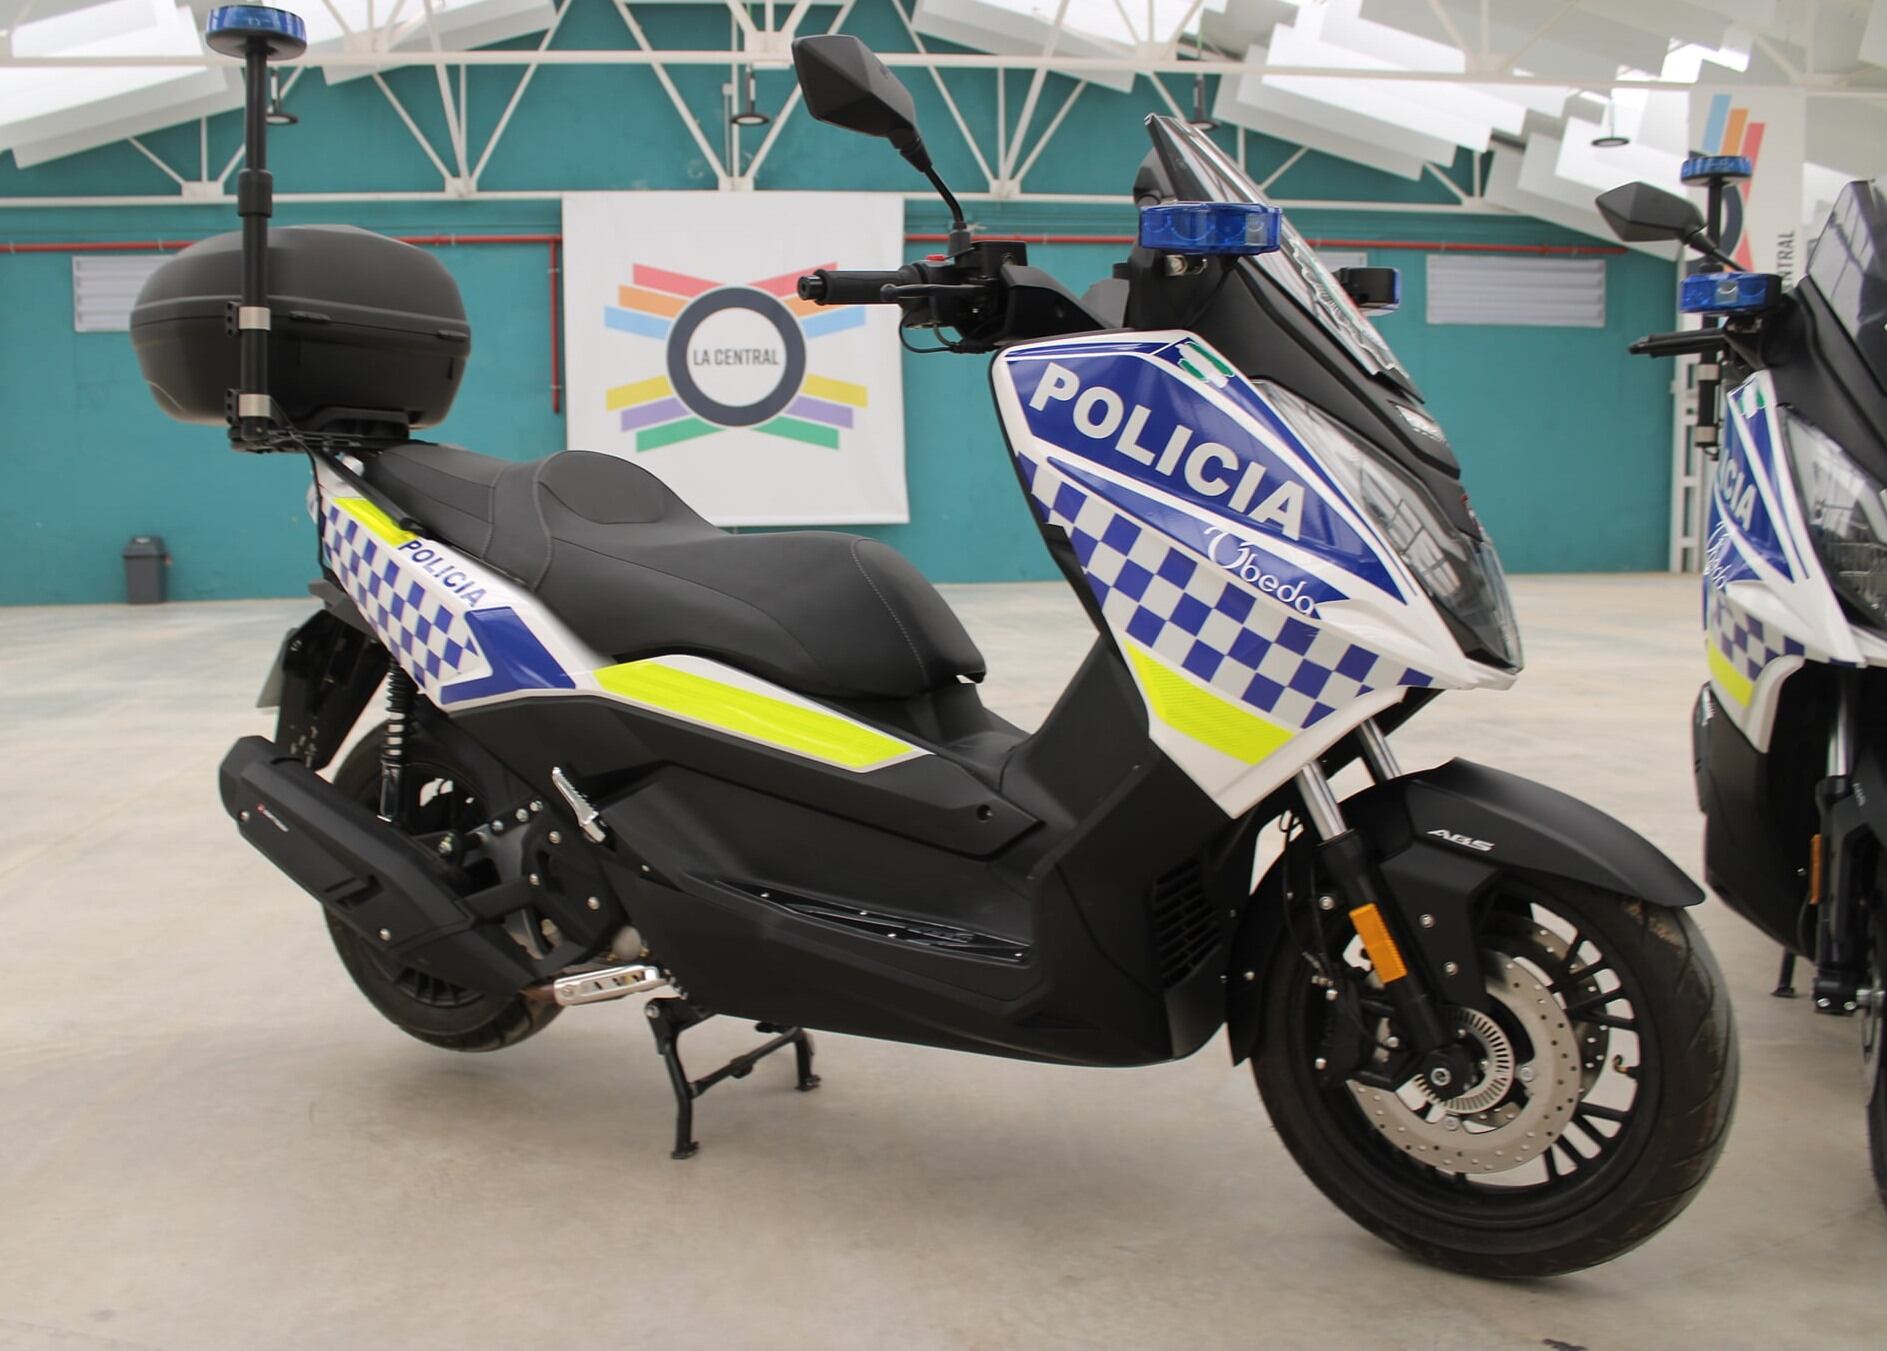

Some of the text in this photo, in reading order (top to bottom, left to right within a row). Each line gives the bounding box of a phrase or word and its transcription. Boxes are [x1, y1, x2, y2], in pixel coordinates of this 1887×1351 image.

[693, 348, 780, 367] LA CENTRAL
[1029, 362, 1306, 542] POLICIA
[398, 540, 487, 608] POLICIA
[1426, 829, 1496, 852] ABS
